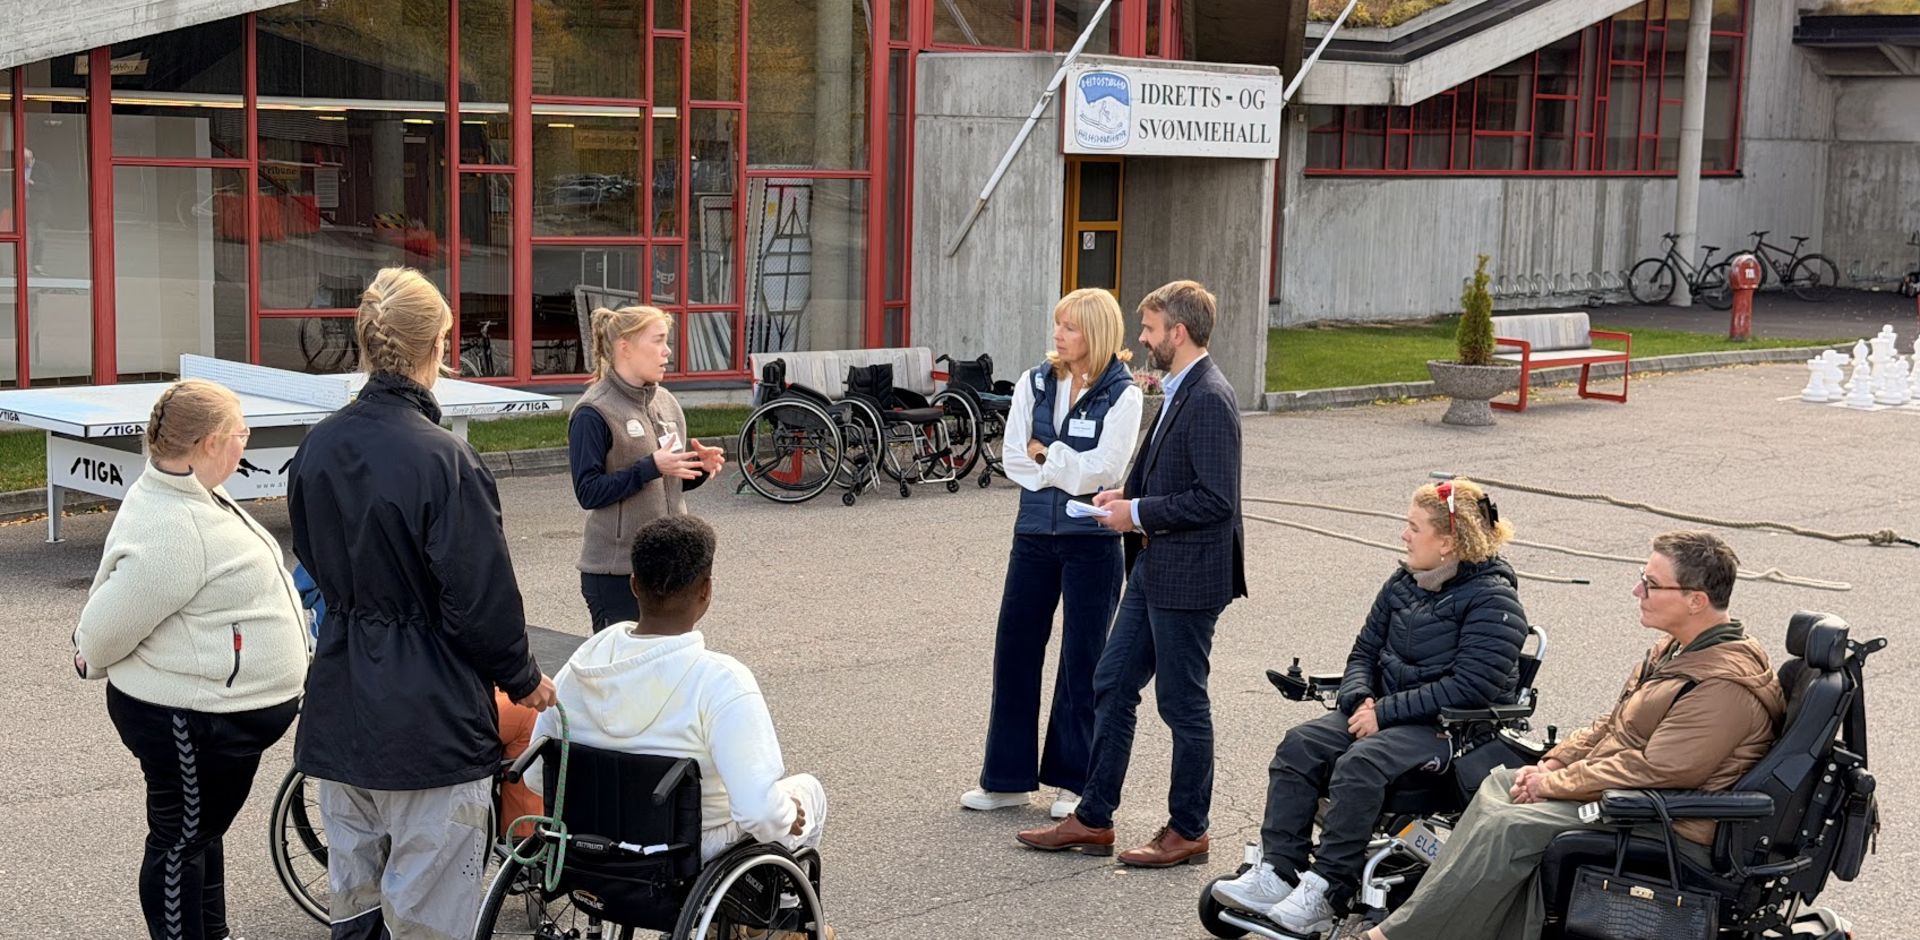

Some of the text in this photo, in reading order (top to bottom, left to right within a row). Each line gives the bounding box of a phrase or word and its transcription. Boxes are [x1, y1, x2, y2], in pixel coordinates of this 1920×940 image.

[1140, 83, 1221, 108] IDRETTS
[1239, 88, 1265, 110] OG
[1138, 118, 1271, 143] SVØMMEHALL
[517, 402, 550, 411] STIGA
[103, 425, 145, 436] STIGA
[70, 457, 123, 487] STIGA
